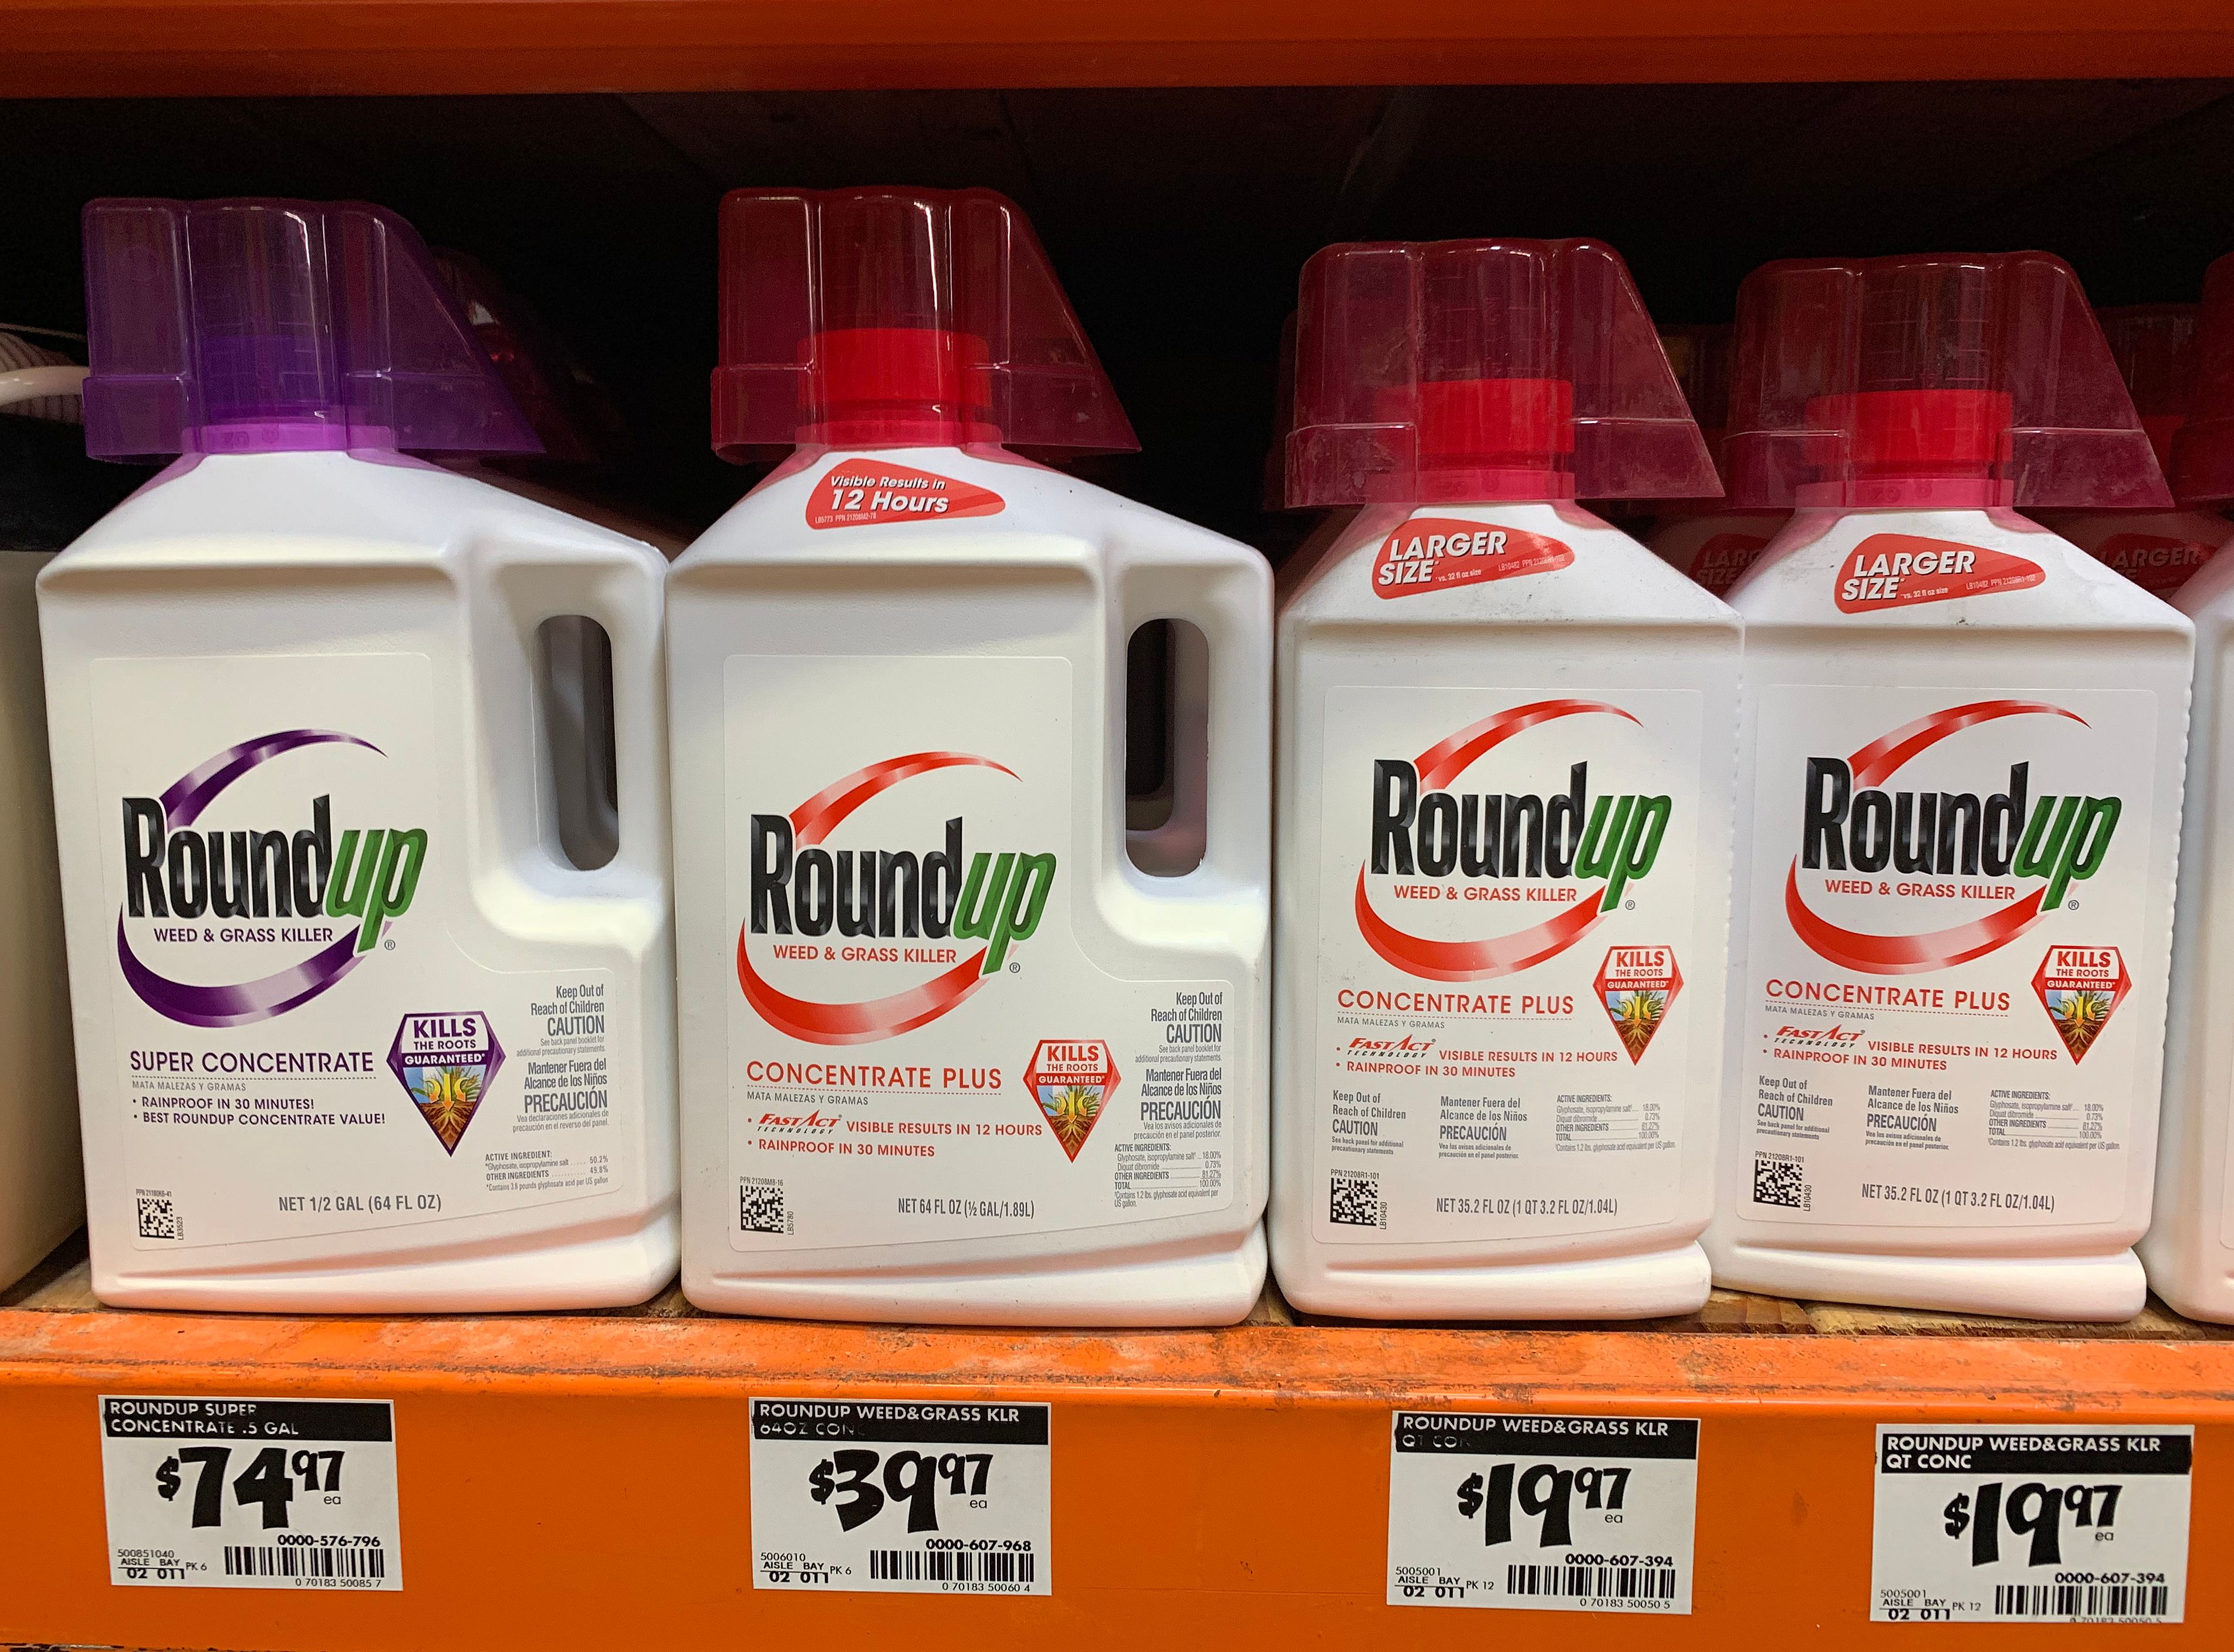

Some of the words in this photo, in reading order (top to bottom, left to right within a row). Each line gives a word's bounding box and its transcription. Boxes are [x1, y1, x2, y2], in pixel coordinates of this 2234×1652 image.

[832, 477, 875, 487] Visible
[880, 477, 928, 488] Results
[932, 478, 945, 489] in
[832, 489, 863, 511] 12
[871, 490, 948, 513] Hours
[1389, 532, 1506, 562] LARGER
[1702, 547, 1761, 567] LARG
[1854, 551, 1975, 577] LARGER
[1371, 759, 1671, 913] Roundup
[1802, 757, 2121, 912] Roundup
[123, 794, 427, 953] Roundup
[751, 814, 1056, 975] Roundup
[1394, 885, 1440, 898] WEED
[1446, 887, 1458, 900] &
[1464, 887, 1520, 900] GRASS
[1526, 888, 1576, 901] KILLER
[154, 929, 197, 942] WEED
[204, 930, 215, 942] &
[220, 929, 275, 942] GRASS
[282, 929, 332, 941] KILLER
[773, 945, 818, 960] WEED
[824, 947, 836, 960] &
[841, 948, 898, 962] GRASS
[904, 949, 956, 962] KILLER
[1616, 951, 1664, 967] KILLS
[556, 985, 577, 1001] Keep
[580, 985, 593, 996] Out
[595, 984, 604, 996] of
[1177, 992, 1197, 1007] Keep
[1199, 992, 1213, 1005] Out
[1215, 992, 1222, 1004] of
[1766, 979, 1943, 1008] CONCENTRATE
[1955, 991, 2010, 1011] PLUS
[531, 1003, 557, 1015] Reach
[559, 1002, 568, 1014] of
[569, 1001, 604, 1014] Children
[1338, 990, 1511, 1013] CONCENTRATE
[1522, 996, 1573, 1014] PLUS
[1151, 1009, 1177, 1021] Reach
[1179, 1009, 1187, 1021] of
[1188, 1008, 1222, 1021] Children
[414, 1019, 476, 1038] KILLS
[547, 1016, 604, 1036] CAUTION
[1167, 1023, 1221, 1043] CAUTION
[414, 1041, 434, 1050] THE
[438, 1040, 476, 1049] ROOTS
[131, 1050, 193, 1072] SUPER
[202, 1052, 373, 1072] CONCENTRATE
[1047, 1046, 1099, 1061] KILLS
[528, 1062, 567, 1075] Mantener
[569, 1060, 592, 1072] Fuera
[594, 1059, 606, 1071] del
[747, 1061, 931, 1087] CONCENTRATE
[944, 1068, 1001, 1089] PLUS
[132, 1081, 155, 1090] MATA
[158, 1082, 195, 1090] MALEZAS
[199, 1082, 203, 1090] Y
[208, 1083, 246, 1091] GRAMAS
[142, 1097, 213, 1109] RAINPROOF
[218, 1099, 230, 1109] IN
[235, 1099, 249, 1109] 30
[255, 1099, 314, 1110] MINUTES!
[525, 1086, 607, 1113] PRECAUCIÓN
[1141, 1096, 1221, 1120] PRECAUCIÓN
[1758, 1103, 1804, 1120] CAUTION
[143, 1113, 168, 1123] BEST
[174, 1114, 234, 1124] ROUNDUP
[239, 1114, 334, 1124] CONCENTRATE
[342, 1114, 385, 1124] VALUE!
[1867, 1113, 1937, 1132] PRECAUCIÓN
[757, 1126, 833, 1134] TECHNOLOGY
[847, 1121, 894, 1133] VISIBLE
[899, 1123, 951, 1134] RESULTS
[957, 1124, 970, 1134] IN
[976, 1124, 990, 1135] 12
[995, 1124, 1042, 1136] HOURS
[511, 1151, 552, 1160] INGREDIENT:
[279, 1197, 305, 1211] NET
[310, 1197, 331, 1211] 1/2
[336, 1197, 363, 1210] GAL
[369, 1196, 391, 1214] (64
[396, 1197, 412, 1210] FL
[418, 1195, 441, 1211] OZ)
[898, 1198, 917, 1213] NET
[920, 1199, 931, 1214] 64
[935, 1200, 945, 1214] FL
[949, 1200, 961, 1215] OZ
[980, 1200, 1034, 1219] GAL/1.89L)
[1437, 1198, 1456, 1213] NET
[1458, 1199, 1479, 1213] 35.2
[1483, 1199, 1495, 1214] FL
[1497, 1200, 1510, 1214] OZ
[1513, 1199, 1521, 1217] (1
[1525, 1200, 1538, 1215] QT
[1540, 1200, 1555, 1214] 3.2
[1558, 1200, 1570, 1214] FL
[1573, 1198, 1617, 1216] OZ/1.04L)
[111, 1402, 199, 1415] ROUNDUP
[205, 1404, 256, 1416] SUPER
[760, 1404, 850, 1418] ROUNDUP
[857, 1406, 981, 1421] WEED&GRASS
[988, 1408, 1019, 1422] KLR
[111, 1420, 235, 1434] CONCENTRATE
[243, 1423, 257, 1434] .5
[265, 1423, 299, 1435] GAL
[816, 1423, 865, 1435] CON
[1404, 1416, 1496, 1431] ROUNDUP
[1503, 1419, 1629, 1435] WEED&GRASS
[1636, 1422, 1668, 1436] KLR
[1886, 1454, 1912, 1468] QT
[1918, 1455, 1971, 1469] CONC
[324, 1495, 341, 1505] ea
[278, 1535, 380, 1547] 0000-576-796
[926, 1539, 1031, 1552] 0000-607-968
[118, 1549, 174, 1558] 500851040
[761, 1552, 806, 1562] 5006010
[1566, 1554, 1673, 1567] 0000-607-394
[127, 1569, 147, 1579] 02
[201, 1563, 207, 1571] 6
[296, 1578, 302, 1586] 0
[305, 1578, 336, 1587] 70183
[340, 1579, 371, 1587] 50085
[376, 1579, 381, 1587] 7
[1466, 1580, 1479, 1589] PK
[1483, 1581, 1493, 1590] 12
[2055, 1573, 2165, 1584] 0000-607-394
[1880, 1590, 1927, 1598] 5005001
